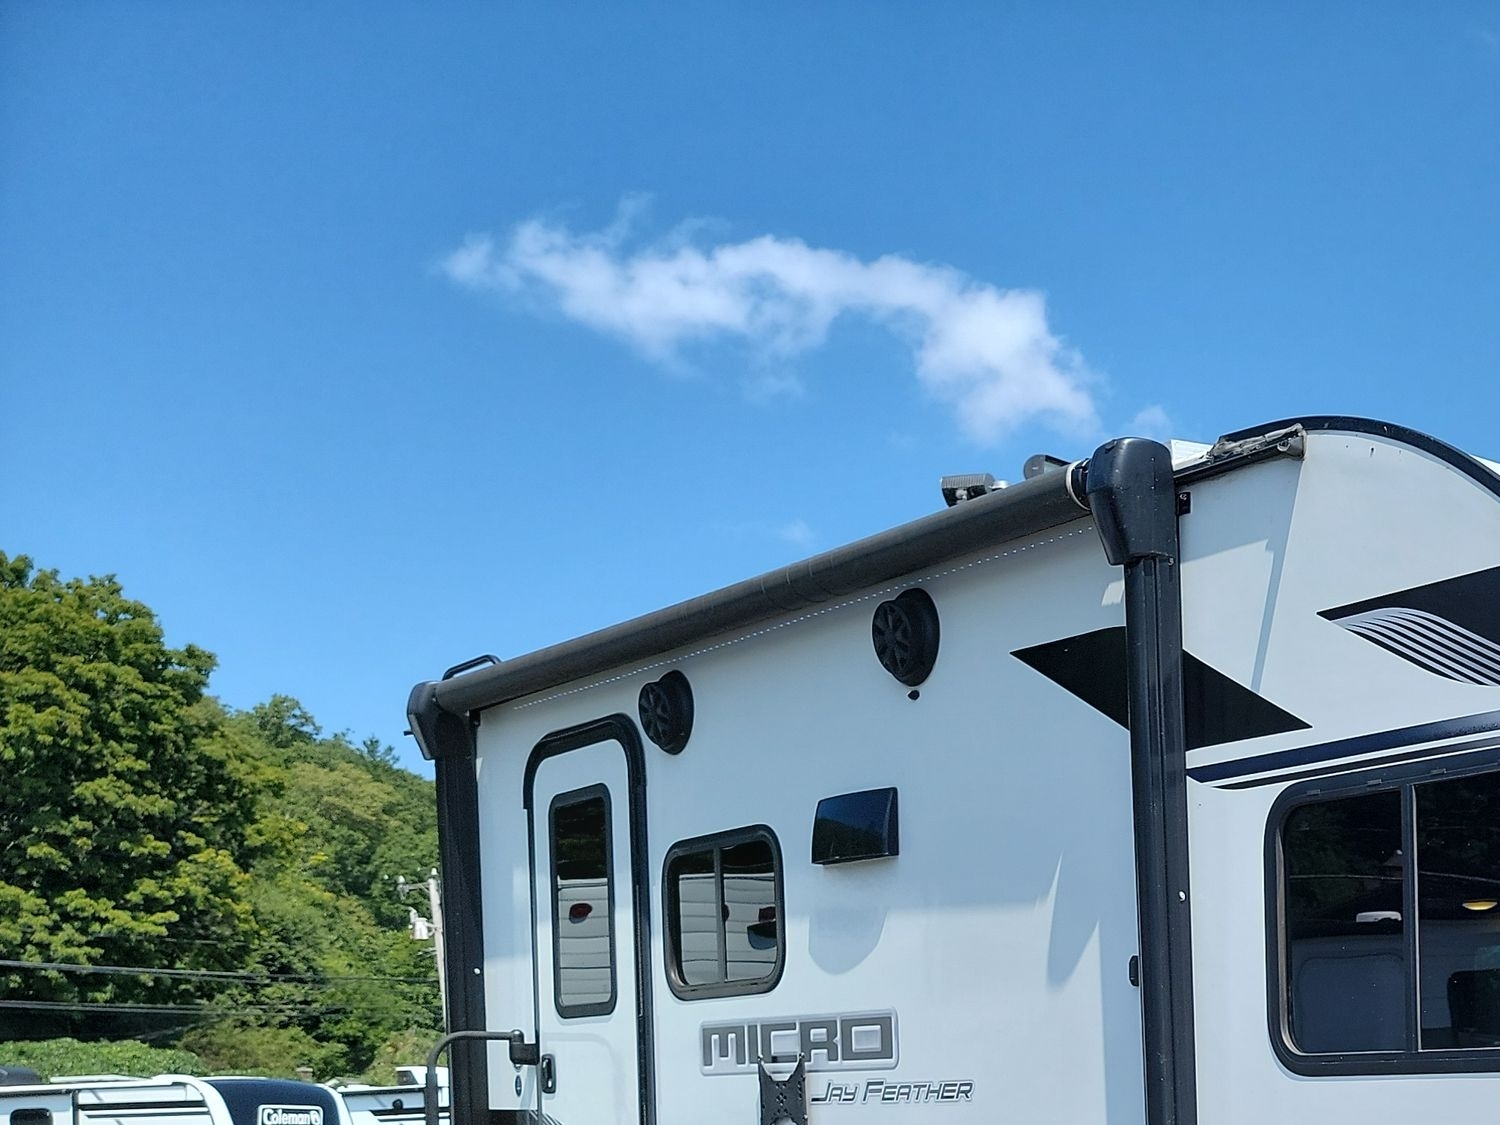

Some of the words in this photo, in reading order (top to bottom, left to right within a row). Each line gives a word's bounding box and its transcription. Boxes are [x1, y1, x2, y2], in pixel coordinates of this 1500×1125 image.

[702, 1015, 894, 1066] MICRO
[862, 1079, 974, 1104] FEATHER
[262, 1108, 311, 1125] Coleman
